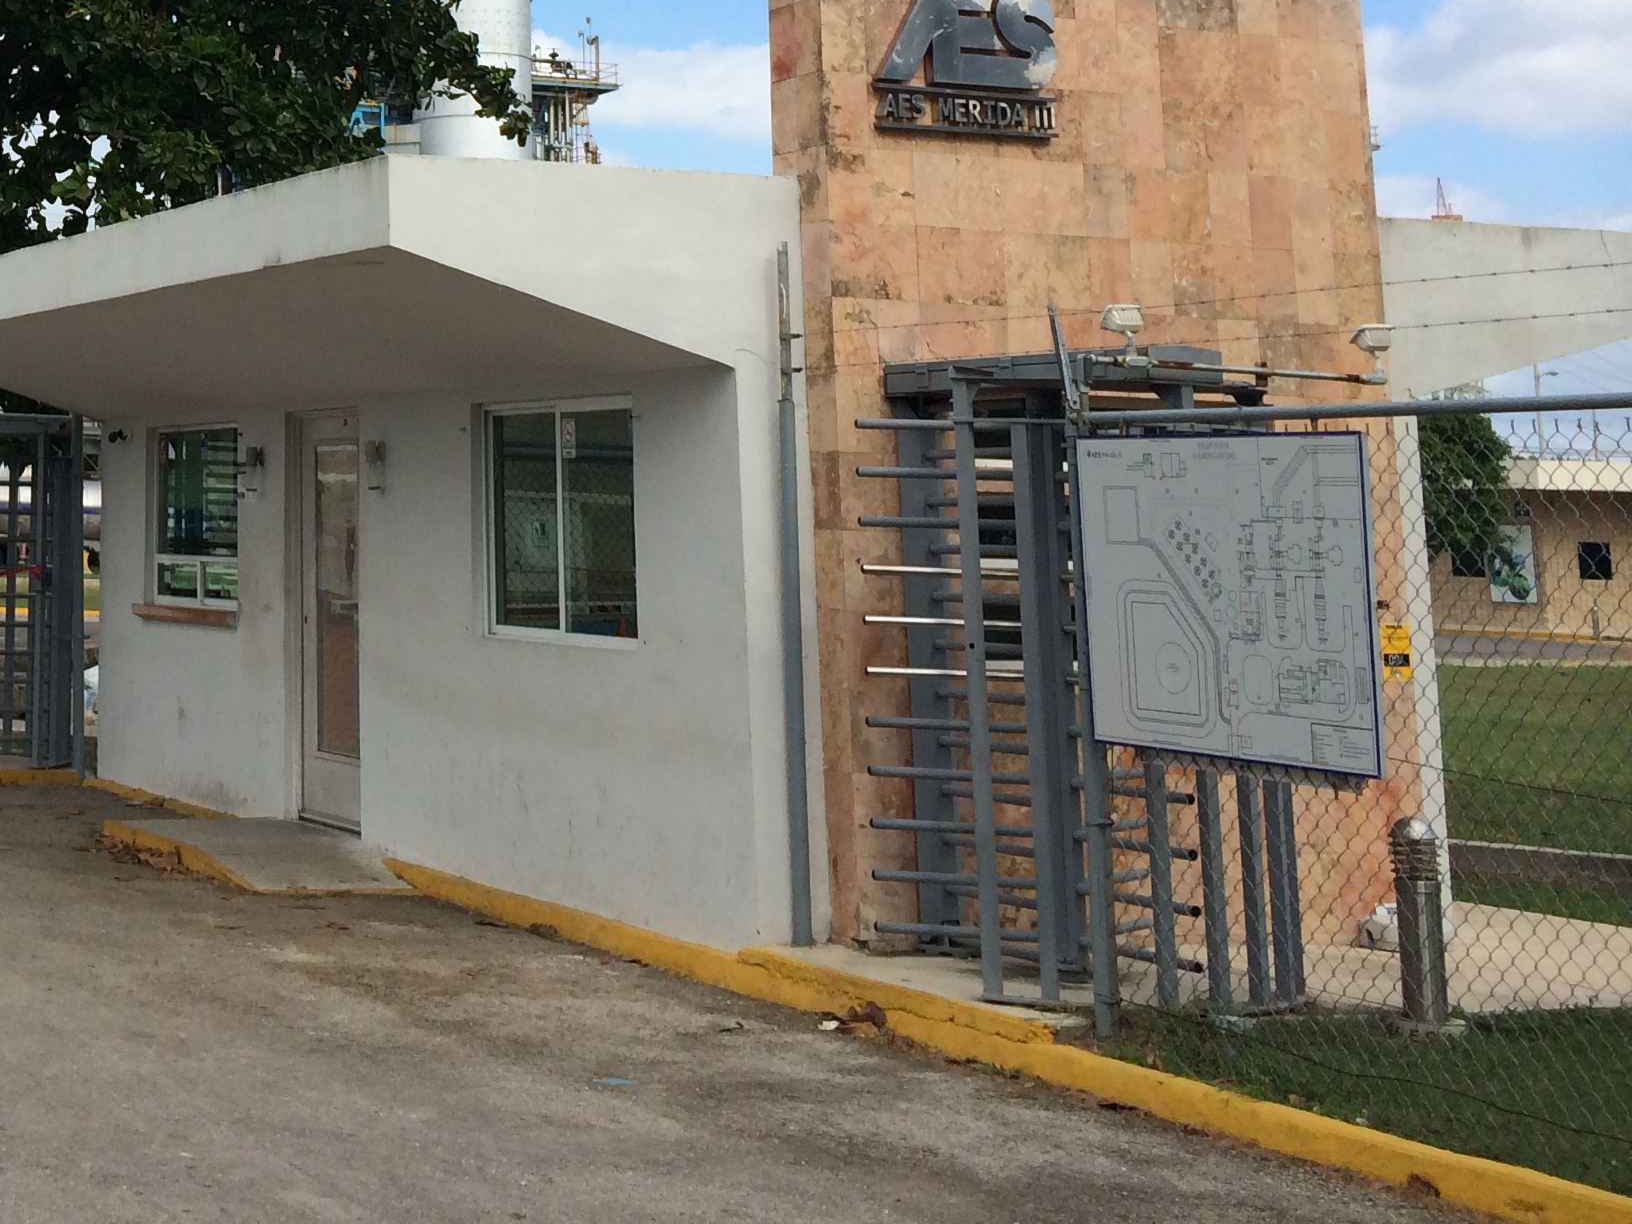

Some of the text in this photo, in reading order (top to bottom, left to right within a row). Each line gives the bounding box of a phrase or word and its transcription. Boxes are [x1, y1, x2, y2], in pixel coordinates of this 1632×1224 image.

[883, 93, 1056, 129] AES MERIDA III
